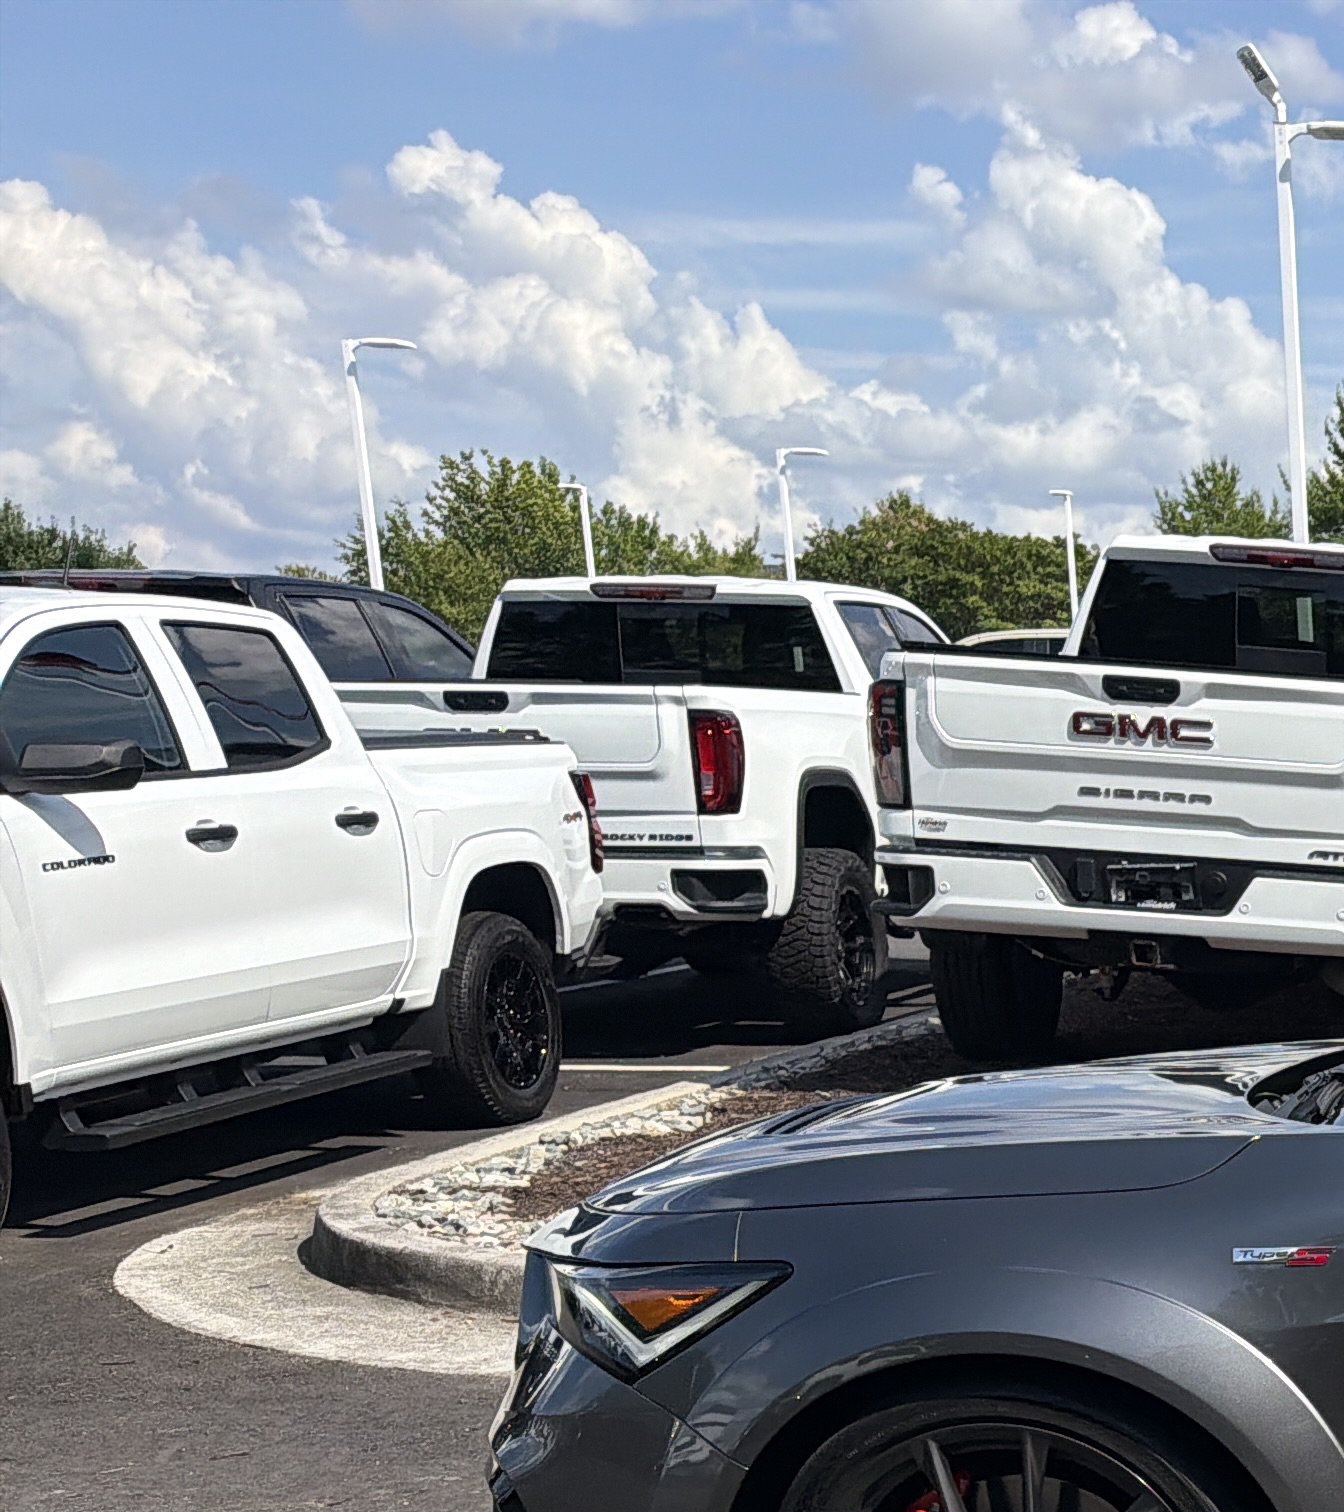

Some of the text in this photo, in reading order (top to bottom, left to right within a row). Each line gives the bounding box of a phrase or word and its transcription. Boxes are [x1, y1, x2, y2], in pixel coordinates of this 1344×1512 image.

[1068, 711, 1215, 749] GMC
[1077, 786, 1213, 806] SIERRA
[41, 854, 116, 873] COLORADO
